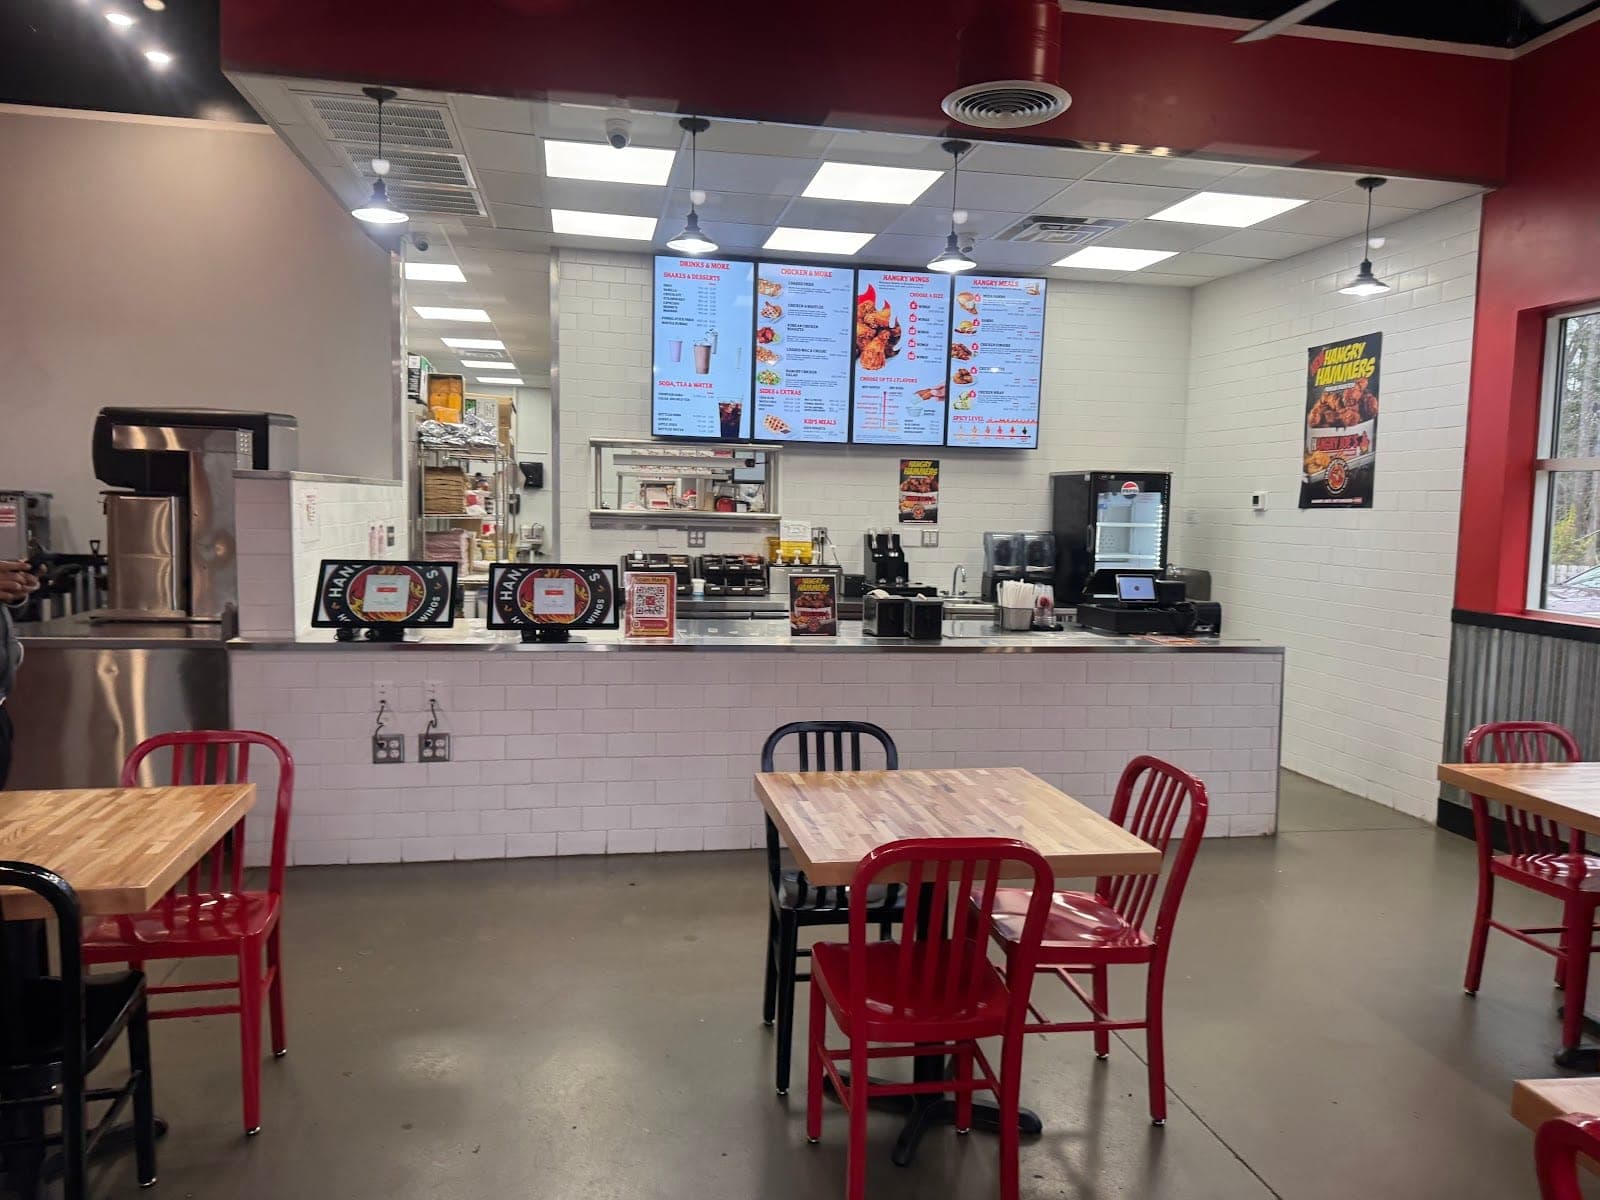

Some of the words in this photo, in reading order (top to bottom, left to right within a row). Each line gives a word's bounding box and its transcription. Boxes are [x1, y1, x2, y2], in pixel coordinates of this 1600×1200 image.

[679, 260, 704, 268] DRINKS
[663, 271, 686, 279] SHAKES
[781, 268, 808, 277] CHICKEN
[813, 270, 833, 278] MORE
[883, 274, 909, 282] HANGRY
[973, 279, 998, 287] HANGRY
[1324, 342, 1367, 366] HANGRY
[1314, 356, 1377, 387] HAMMERS
